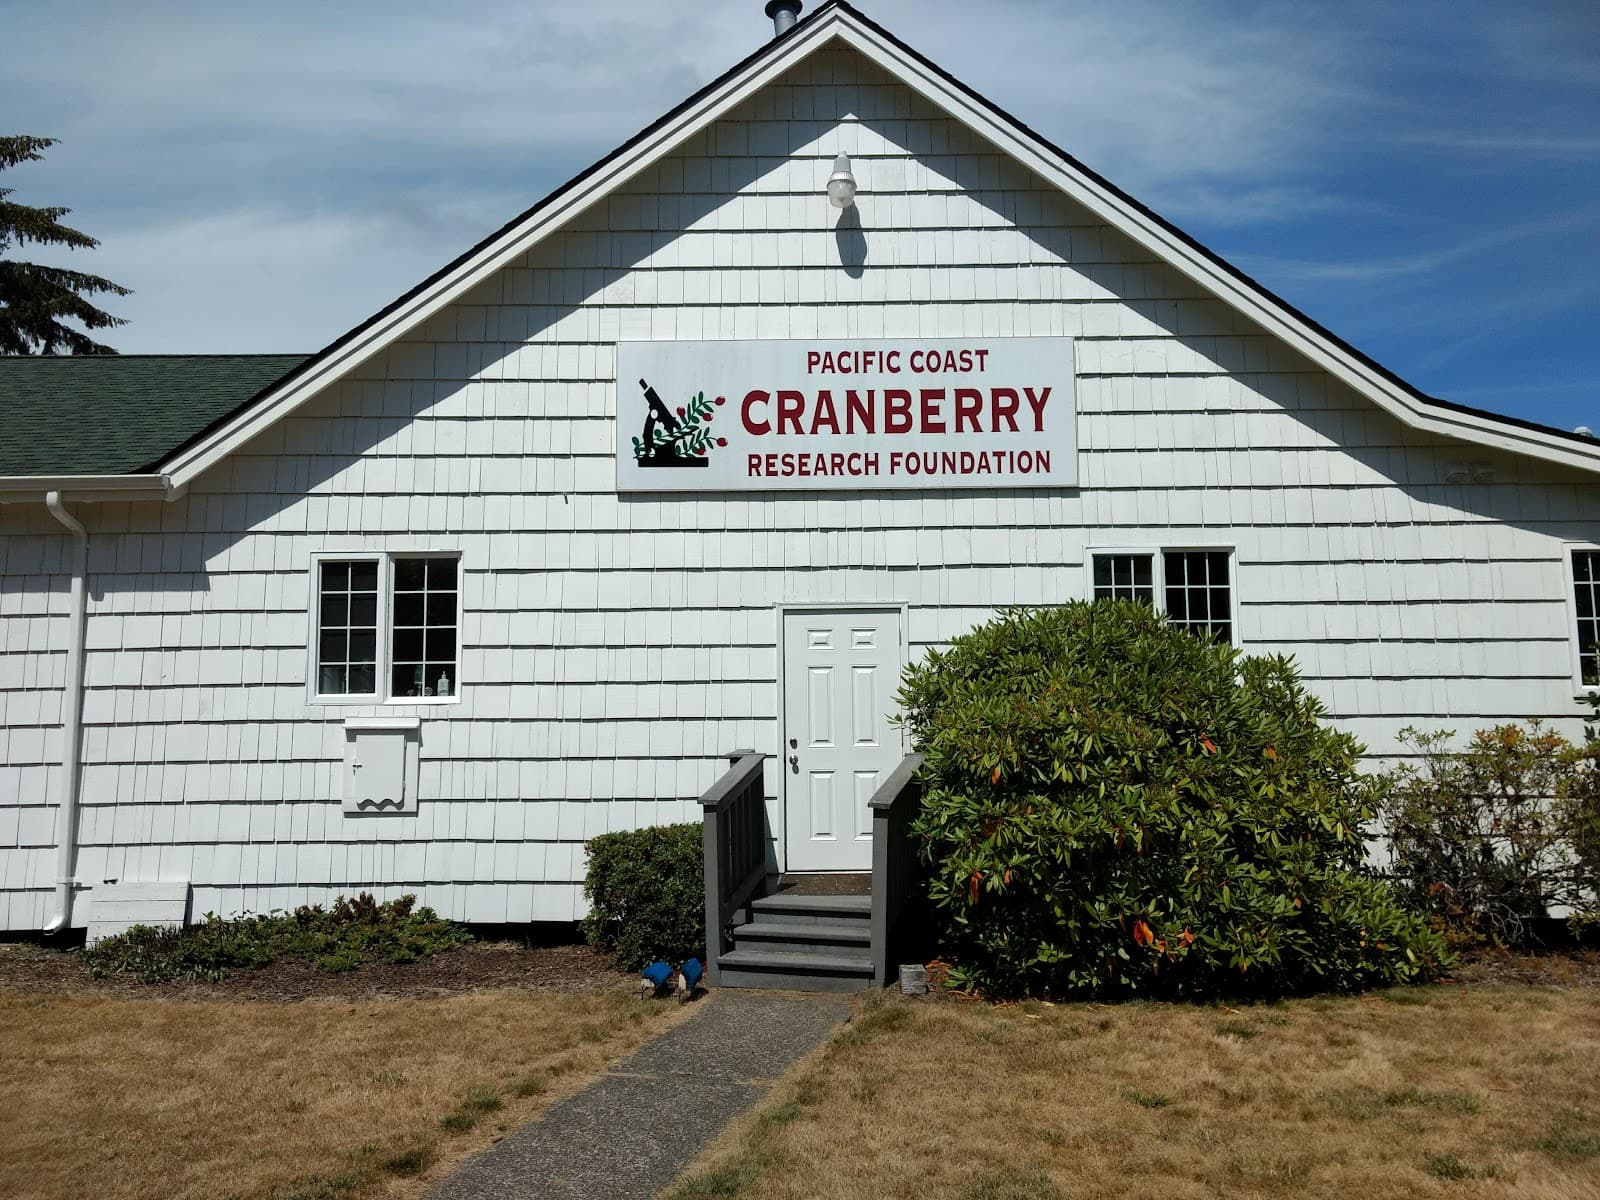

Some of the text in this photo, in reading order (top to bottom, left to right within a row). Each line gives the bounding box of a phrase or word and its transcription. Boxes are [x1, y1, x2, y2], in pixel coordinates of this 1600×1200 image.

[807, 349, 989, 374] PACIFIC COAST
[740, 387, 1052, 436] CRANBERRY
[747, 450, 1051, 477] RESEARCH FOUNDATION
